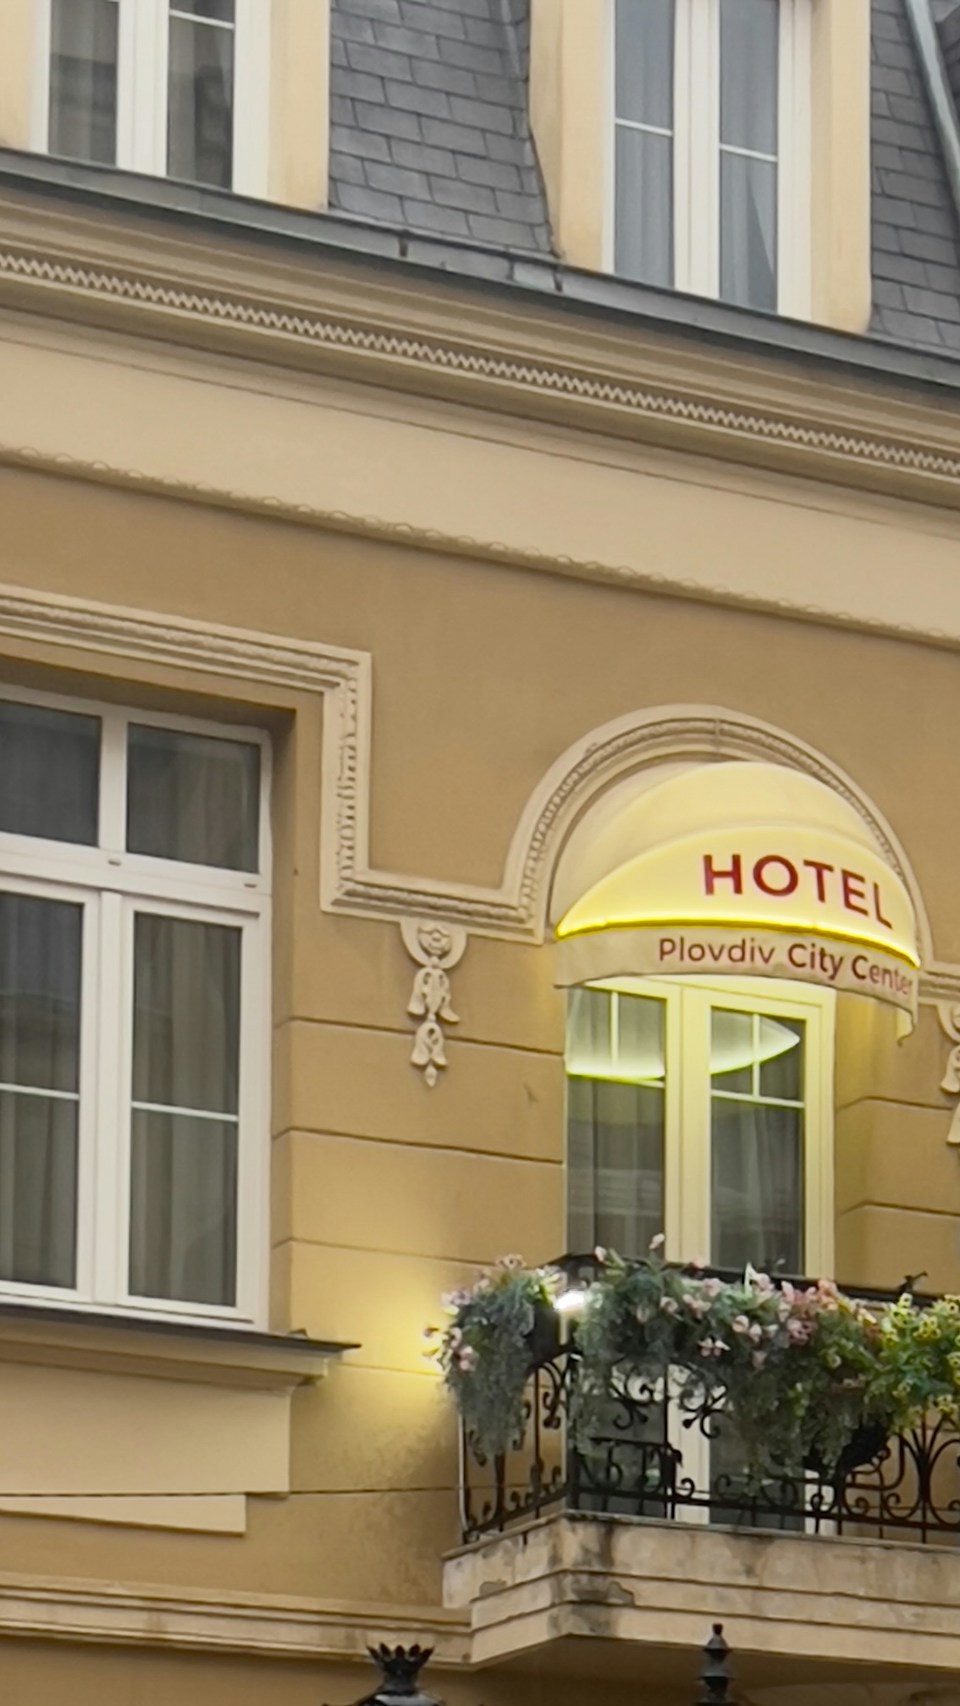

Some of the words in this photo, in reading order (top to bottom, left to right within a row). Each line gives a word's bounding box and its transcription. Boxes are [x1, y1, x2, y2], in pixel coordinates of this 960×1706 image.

[702, 854, 893, 930] HOTEL
[658, 937, 776, 965] Plovdiv
[786, 942, 845, 981] City
